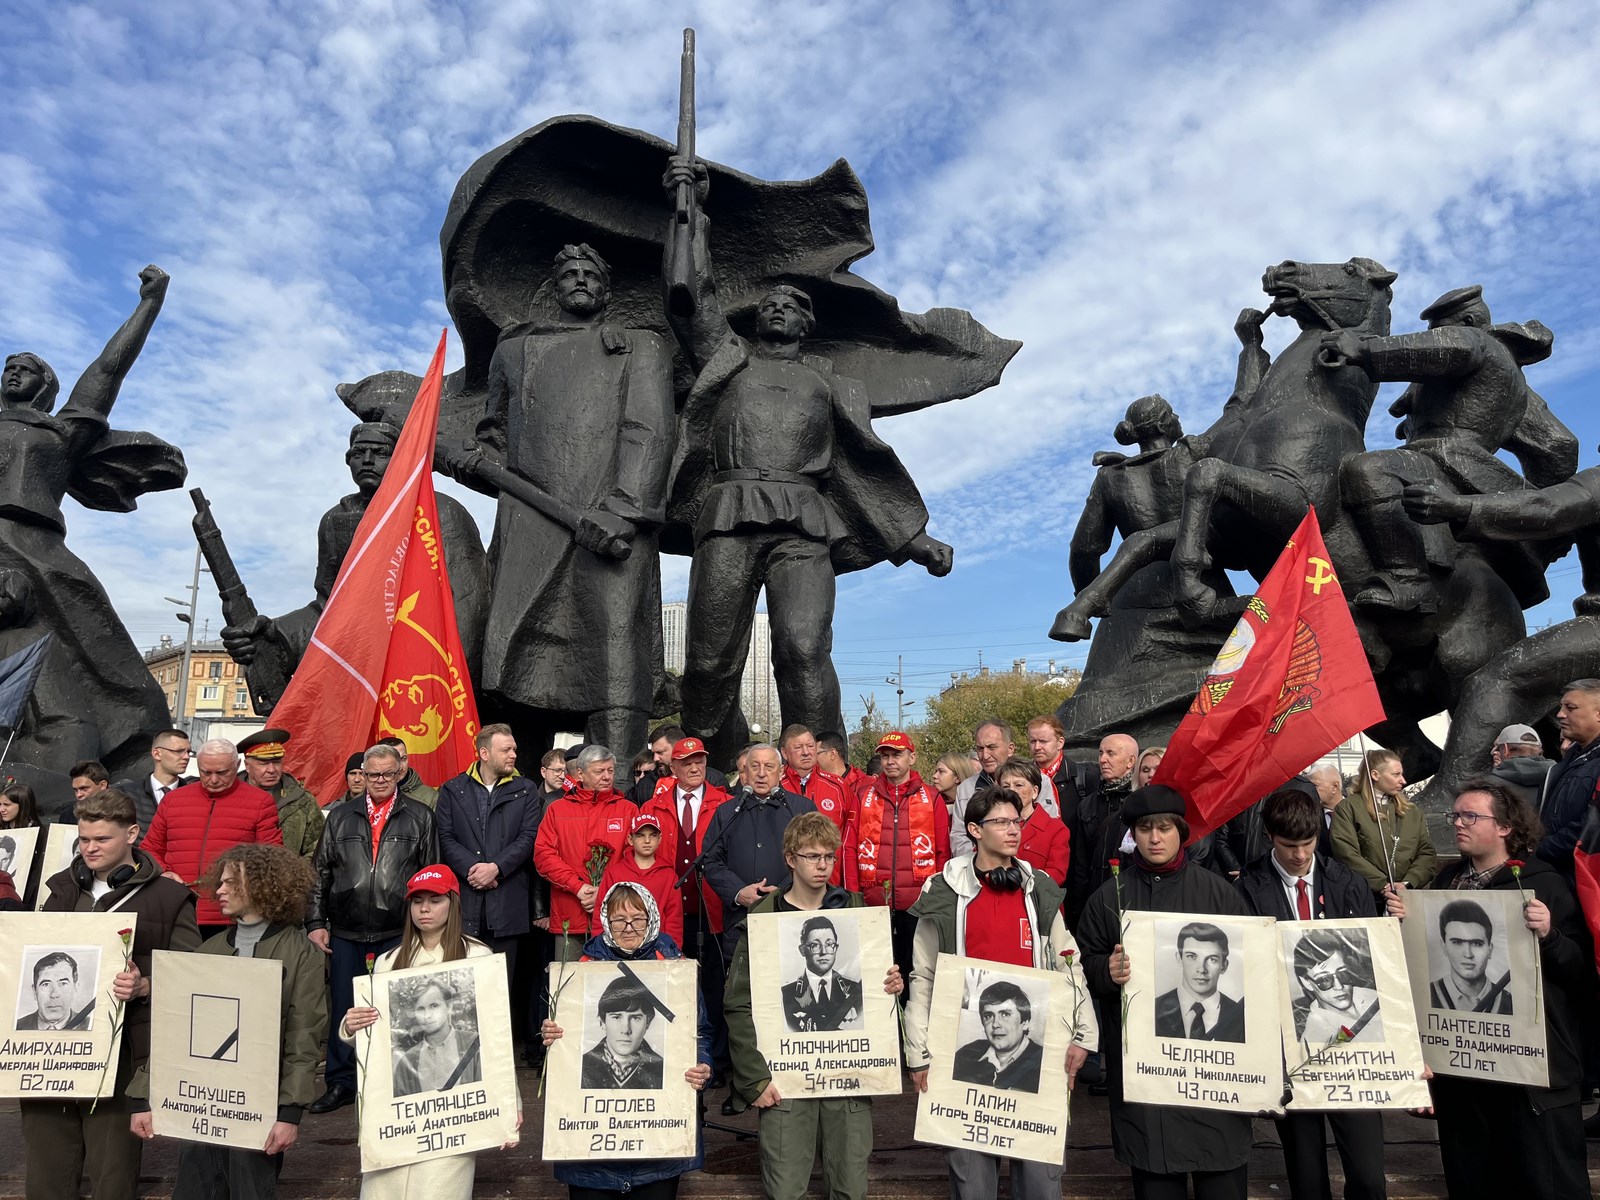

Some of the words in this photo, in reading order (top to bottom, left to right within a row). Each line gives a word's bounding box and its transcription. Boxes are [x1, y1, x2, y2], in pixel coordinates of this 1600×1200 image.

[881, 734, 902, 743] СССР
[414, 871, 443, 883] КПРФ
[1428, 1013, 1511, 1038] ПАНТЕЛЕЕВ
[0, 1039, 93, 1056] АМИРХАНОВ
[780, 1038, 870, 1056] КЛЮЧНИКОВ
[1162, 1042, 1235, 1066] ЧЕЛЯКОВ
[1419, 1032, 1450, 1047] ГОРЬ
[1455, 1035, 1545, 1058] ВЛАДИМИРОВИЧ
[815, 1057, 897, 1070] АЛЕКСАНДРОВИЧ
[1449, 1050, 1472, 1069] 20
[1474, 1059, 1497, 1072] ЛЕТ
[20, 1073, 45, 1091] 62
[805, 1073, 827, 1092] 54
[1136, 1061, 1187, 1078] НИКОЛАЙ
[1194, 1066, 1266, 1085] НИКОЛАЕВИЧ
[1358, 1068, 1416, 1081] ЮРЬЕВИЧ
[178, 1080, 246, 1105] СОКУШЕВ
[966, 1088, 1017, 1113] ПАПИН
[1178, 1081, 1200, 1100] 43
[1323, 1084, 1353, 1102] 23
[161, 1097, 208, 1116] АНАТОЛИЙ
[210, 1104, 263, 1123] СЕМЕНОВИЧ
[391, 1089, 487, 1120] ТЕМЛЯНЦЕВ
[583, 1095, 656, 1114] ГОГОЛЕВ
[192, 1117, 209, 1136] 48
[211, 1126, 229, 1139] ЛЕТ
[379, 1120, 416, 1140] ЮРИЙ
[422, 1107, 500, 1132] АНАТОЛЬЕВИЧ
[558, 1117, 599, 1131] ВИКТОР
[608, 1116, 688, 1130] ВАЛЕНТИНОВИЧ
[930, 1102, 969, 1121] ИГОРЬ
[974, 1109, 1058, 1136] ВЯЧЕСЛАВОВИЧ
[416, 1131, 444, 1154] 30
[445, 1133, 467, 1149] ЛЕТ
[589, 1133, 617, 1152] 26
[619, 1139, 645, 1152] ЛЕТ
[962, 1123, 989, 1145] 38
[990, 1134, 1015, 1149] ЛЕТ
